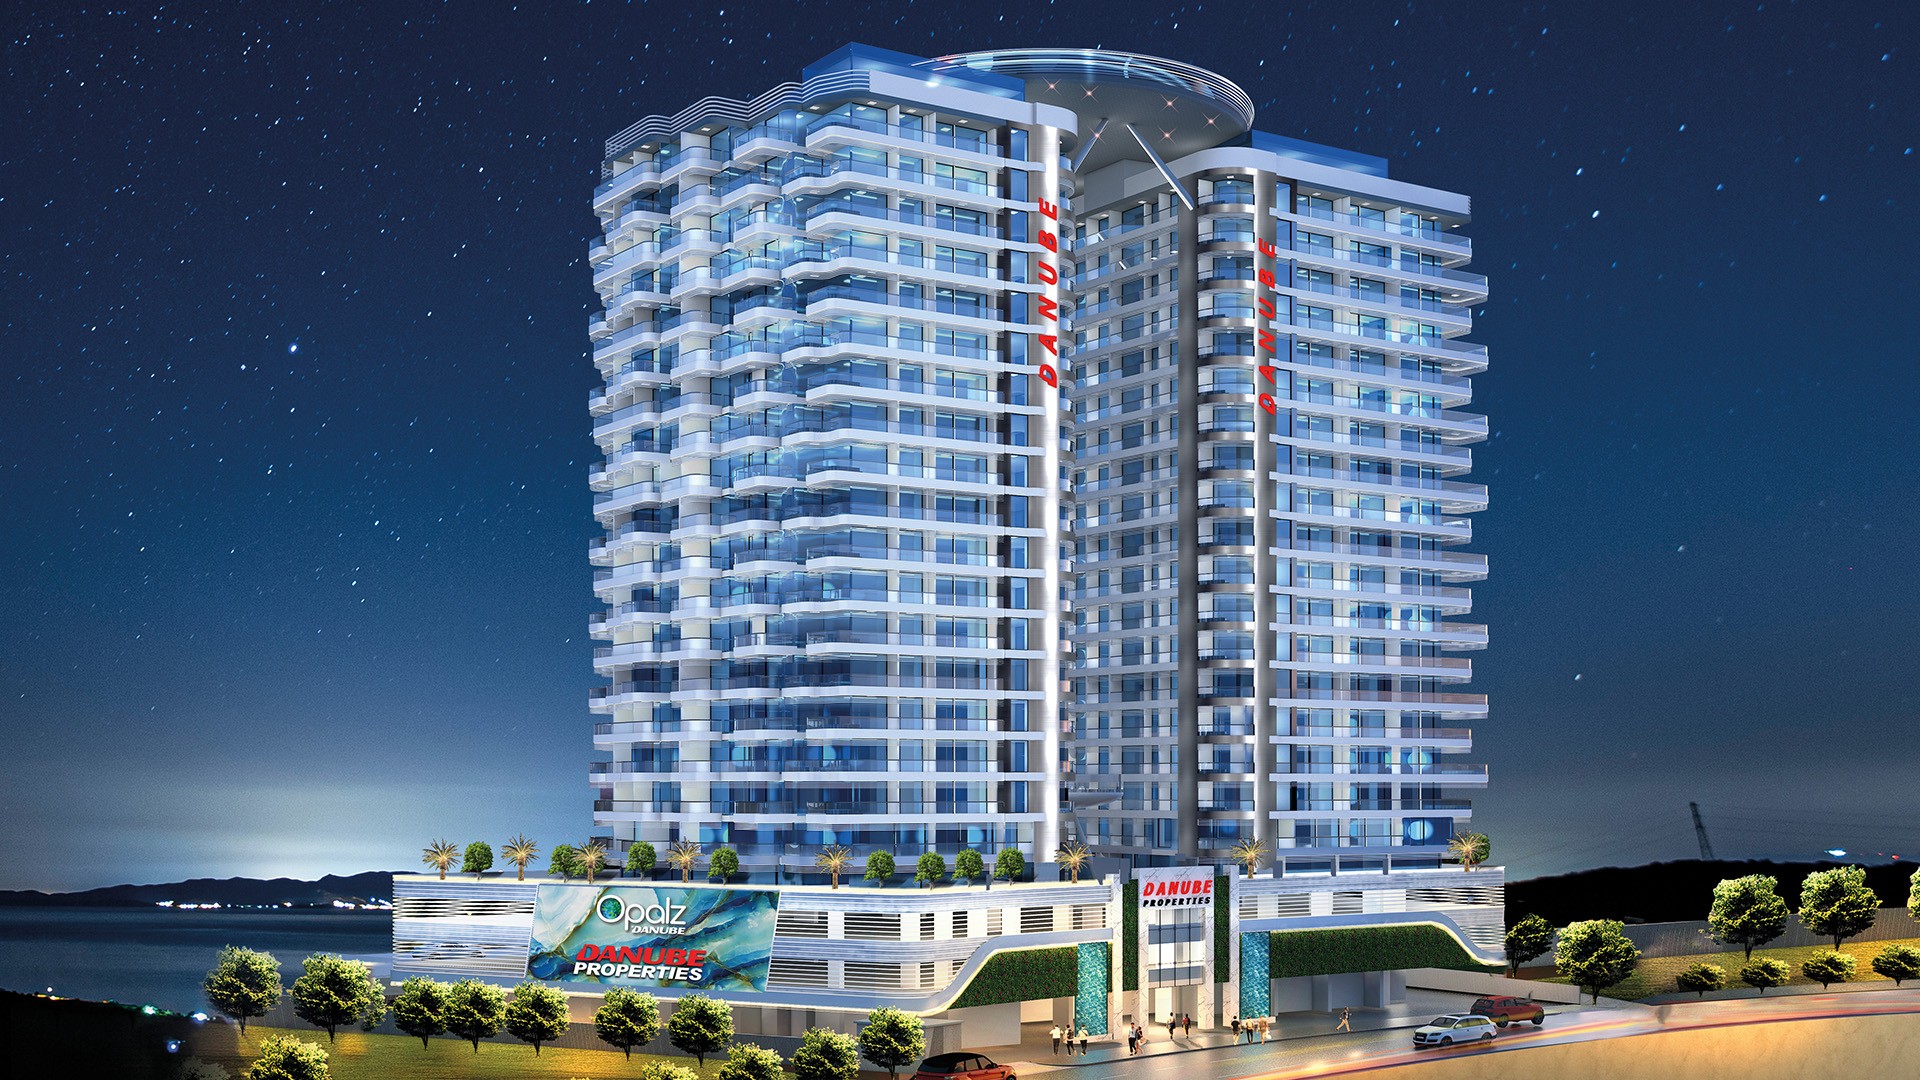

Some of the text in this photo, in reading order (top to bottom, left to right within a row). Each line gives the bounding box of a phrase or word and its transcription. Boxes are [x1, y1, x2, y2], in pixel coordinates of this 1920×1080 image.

[1038, 197, 1058, 388] DANUBE
[1258, 238, 1276, 416] DANUBE
[1143, 880, 1213, 897] DANUBE
[597, 894, 686, 931] Opalz
[1143, 897, 1211, 907] PROPERTIES
[631, 926, 685, 935] DANUBE
[576, 944, 707, 967] DANUBE
[573, 962, 703, 981] PROPERTIES
